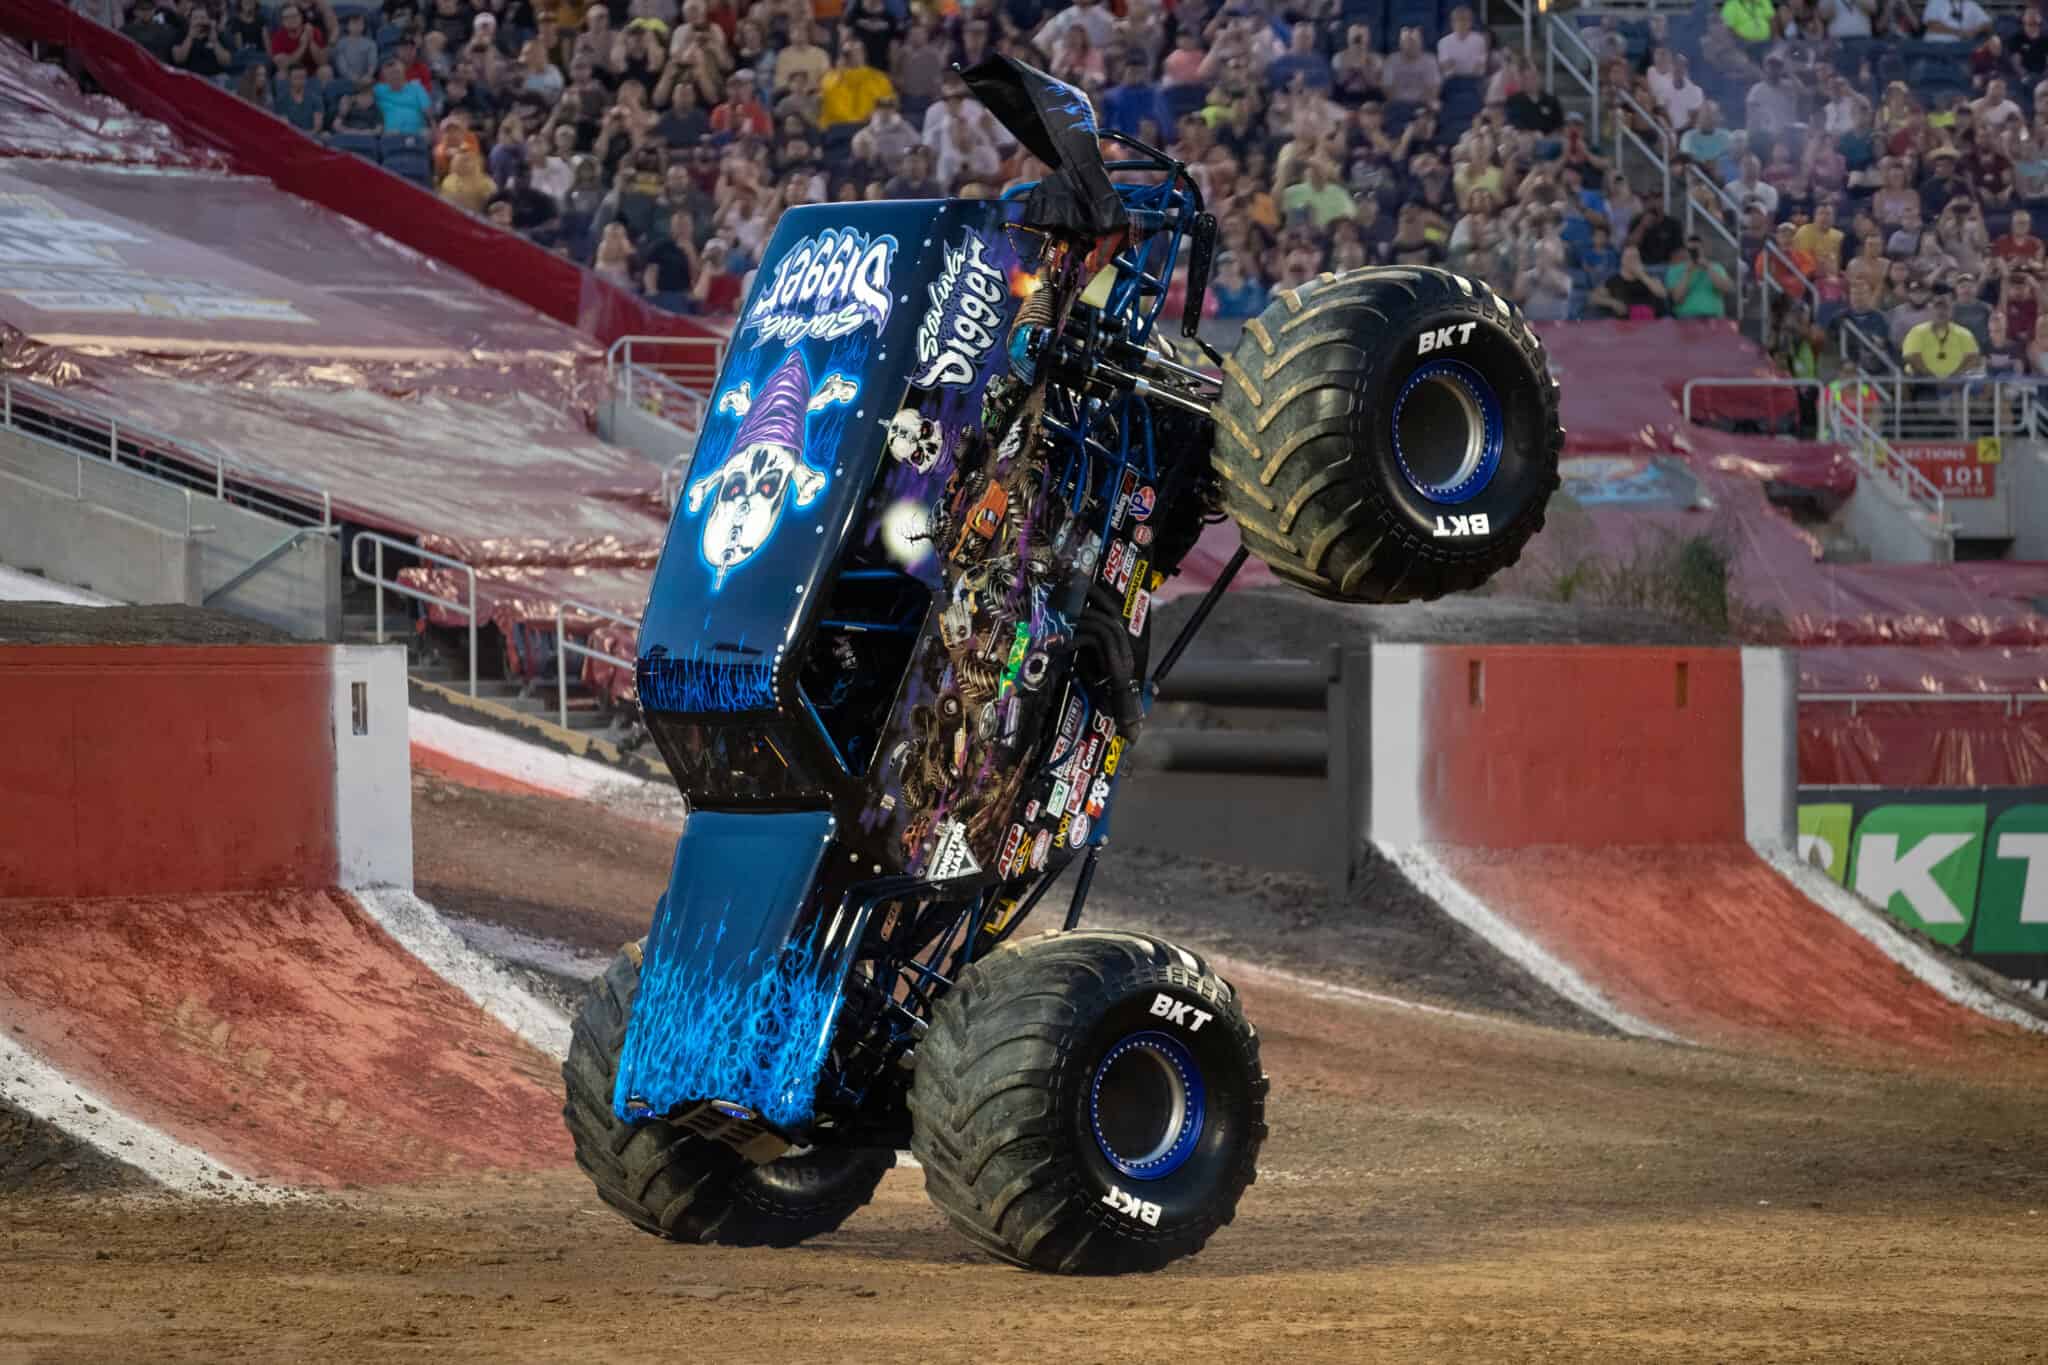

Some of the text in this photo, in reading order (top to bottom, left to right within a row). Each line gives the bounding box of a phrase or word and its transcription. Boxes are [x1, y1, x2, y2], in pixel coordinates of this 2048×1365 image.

[750, 229, 894, 326] Digger
[915, 236, 1005, 387] Digger
[1416, 321, 1477, 355] BKT
[1943, 466, 1984, 485] 101
[1129, 493, 1151, 517] VP
[1432, 512, 1491, 537] BKT
[1104, 538, 1124, 582] MSD
[1082, 738, 1099, 770] Coan
[1000, 824, 1020, 876] ARP
[1149, 993, 1214, 1032] BKT
[1101, 1185, 1162, 1226] BKT
